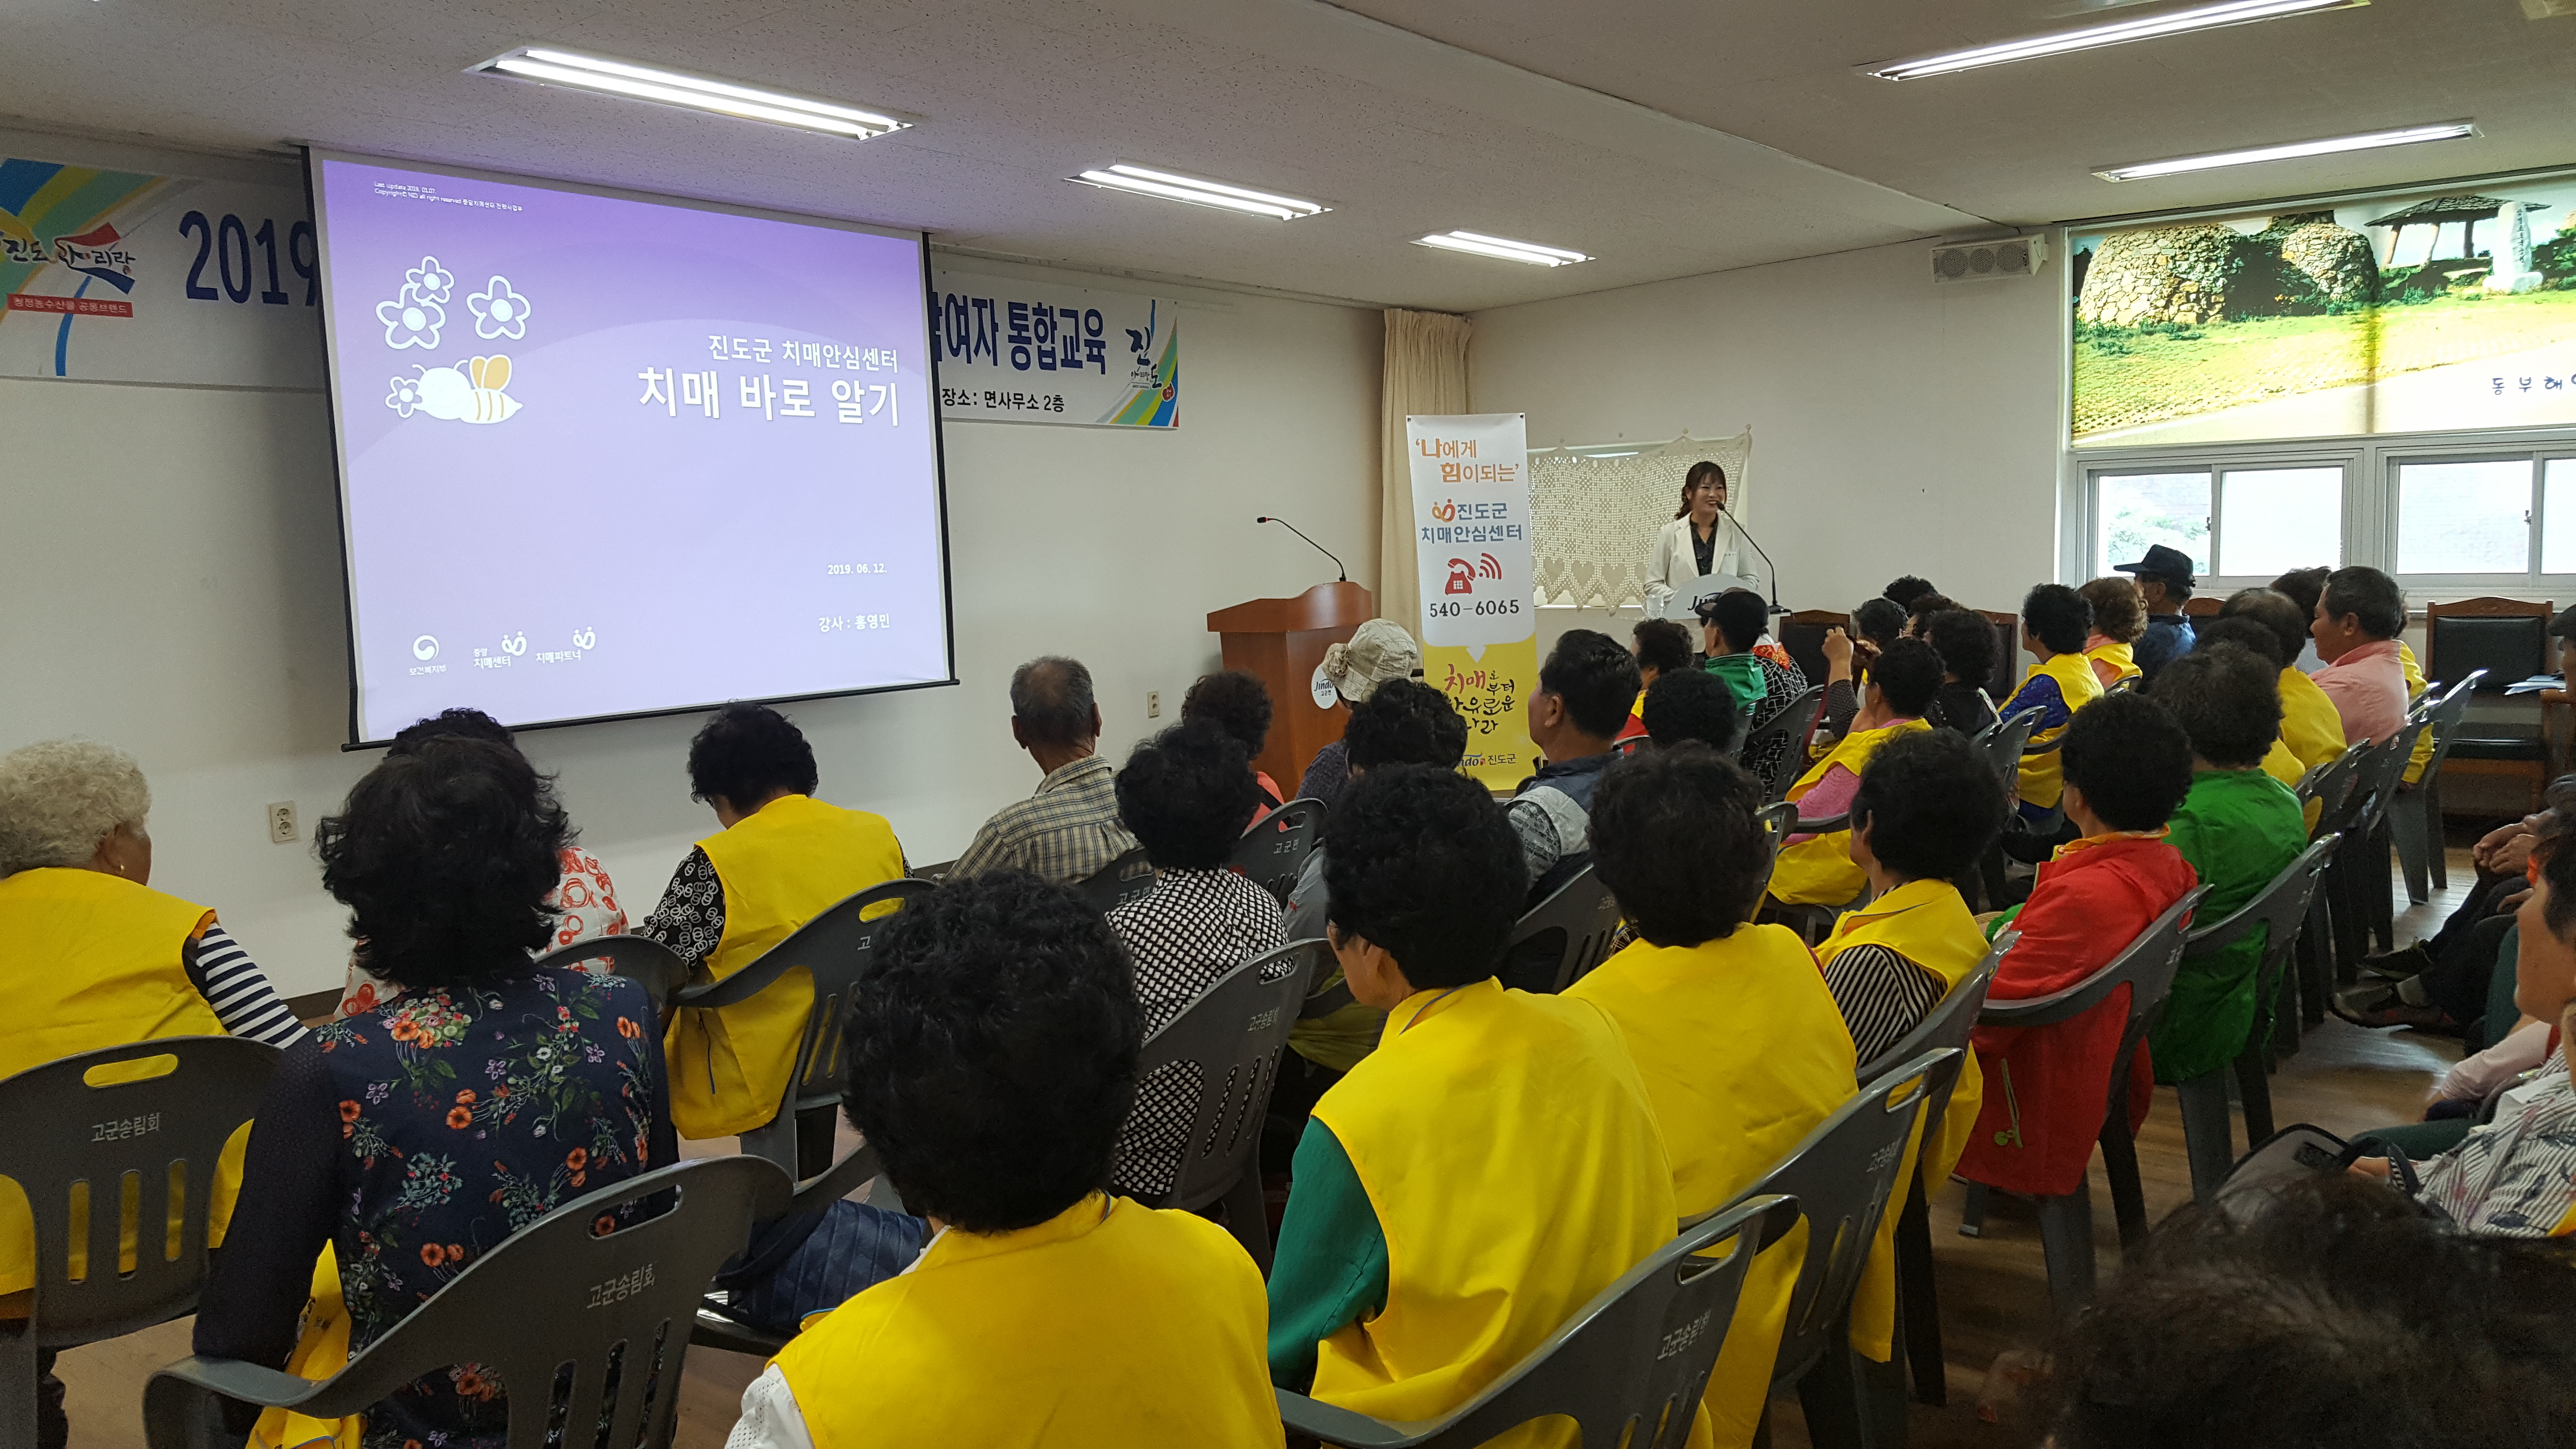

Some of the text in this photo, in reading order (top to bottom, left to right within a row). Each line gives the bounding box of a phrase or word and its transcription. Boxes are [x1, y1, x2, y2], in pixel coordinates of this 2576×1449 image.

[178, 210, 317, 307] 2019
[79, 301, 128, 314] 공동브랜드
[1007, 301, 1106, 375] 통합교육
[708, 335, 898, 373] 진도군 치매안심센터
[2492, 374, 2576, 395] 동부해
[638, 367, 899, 426] 치매 바로 알기
[942, 387, 1064, 413] 장소: 면사무소 2층
[1457, 502, 1508, 521] 진도군
[1421, 524, 1523, 544] 치매안심센터
[828, 563, 887, 575] 2019. 06. 12.
[1429, 599, 1520, 618] 540-6065
[819, 616, 843, 632] 강사
[854, 613, 890, 630] 홍영민
[473, 648, 488, 657] 중앙
[535, 649, 581, 664] 치매파트너
[409, 664, 447, 676] 보건복지부
[473, 656, 511, 669] 치매센터
[1488, 754, 1516, 765] 진도군
[1273, 837, 1300, 854] 고군면
[91, 1112, 160, 1142] 고군송림회
[586, 1263, 655, 1309] 고군송림회
